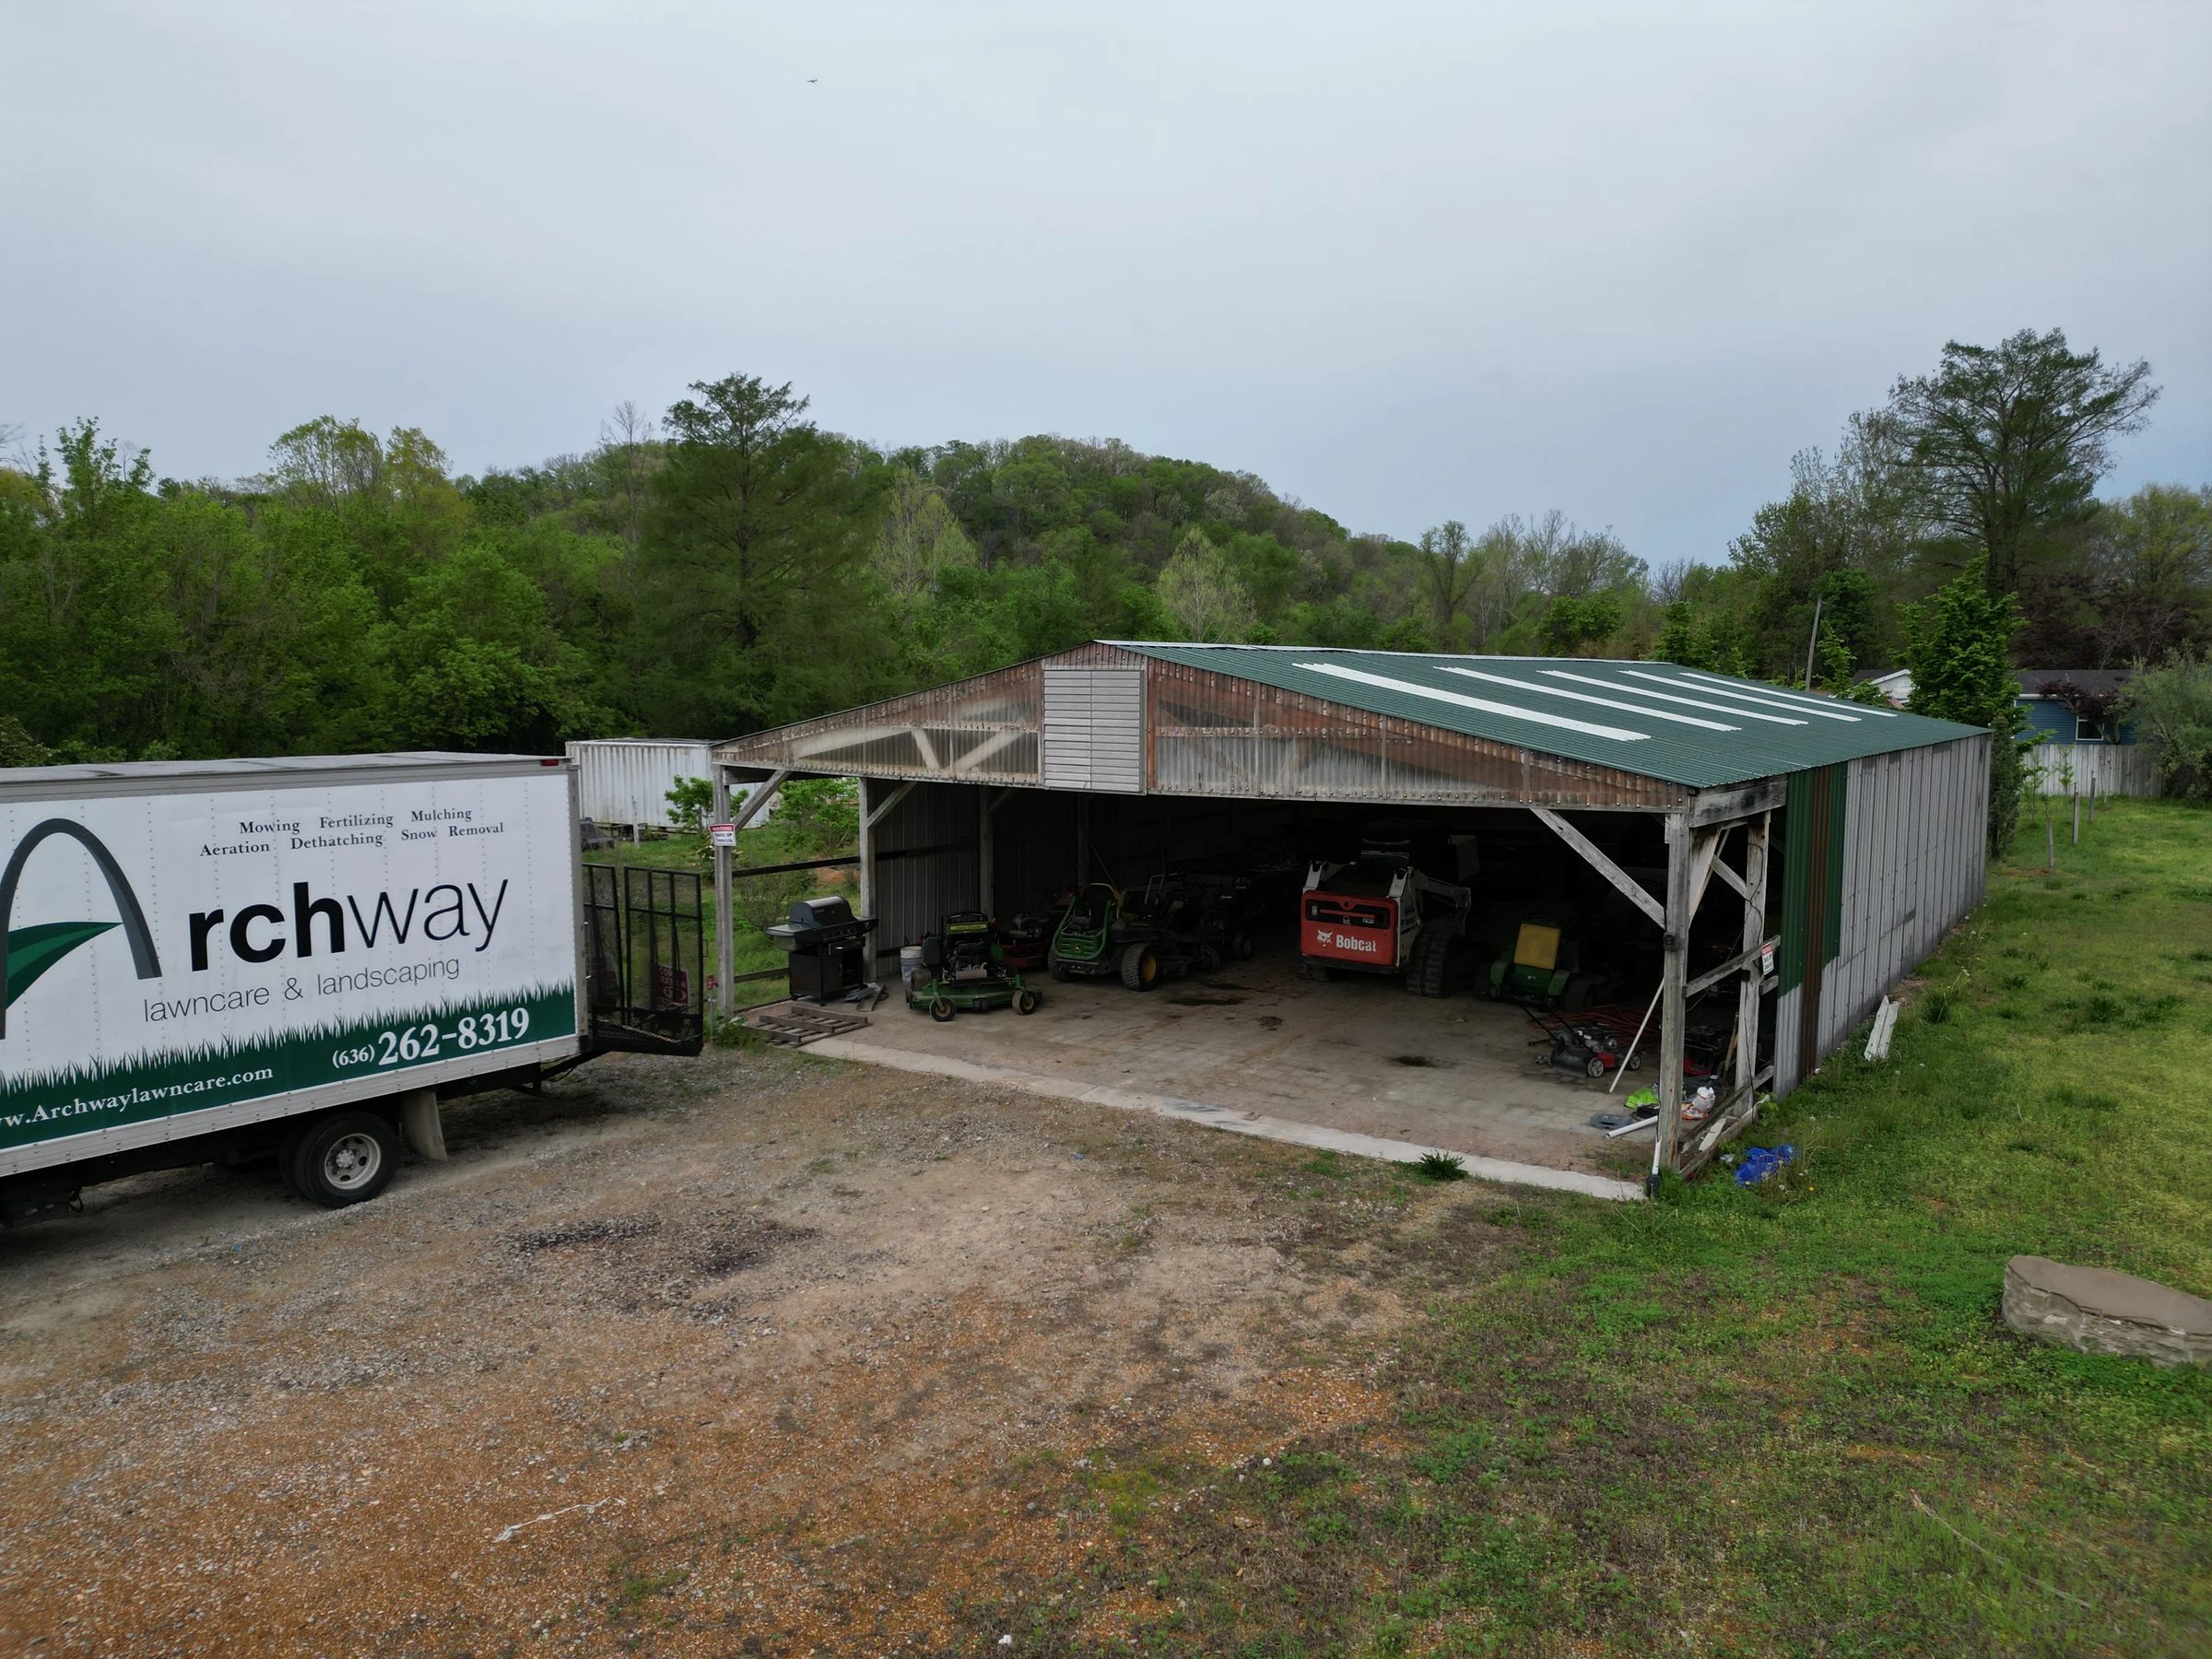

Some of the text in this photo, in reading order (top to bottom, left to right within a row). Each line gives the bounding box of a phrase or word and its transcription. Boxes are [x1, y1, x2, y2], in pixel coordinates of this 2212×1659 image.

[240, 807, 472, 835] Mowing Fertilizing Mulching
[199, 822, 504, 856] Aeration Dethatching Snow Removal
[1335, 934, 1377, 953] Bobcat
[144, 958, 460, 1023] lawncare & landscaping
[333, 1007, 530, 1069] (636) 262-8319
